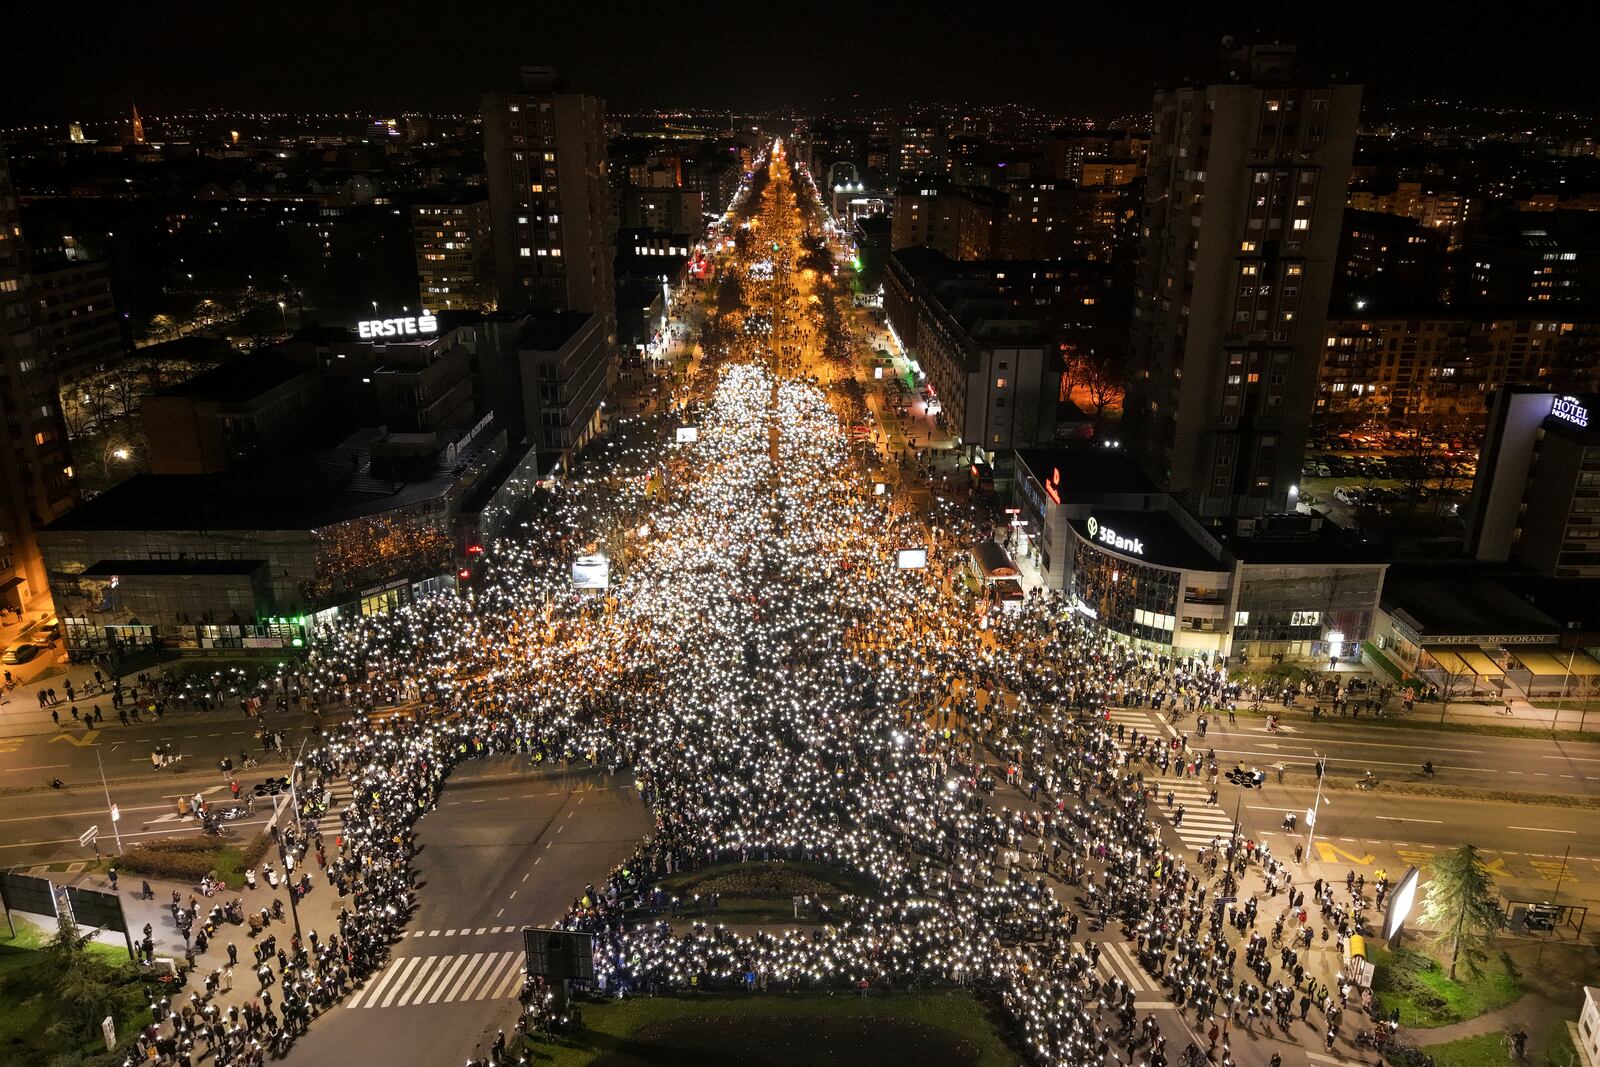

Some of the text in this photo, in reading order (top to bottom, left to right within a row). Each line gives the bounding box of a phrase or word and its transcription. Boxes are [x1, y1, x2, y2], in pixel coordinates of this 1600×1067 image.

[358, 317, 417, 338] ERSTE
[1551, 408, 1587, 427] NOVI SAD
[1553, 398, 1588, 420] HOTEL
[1099, 525, 1144, 555] 3Bank
[1488, 635, 1544, 643] RESTORAN
